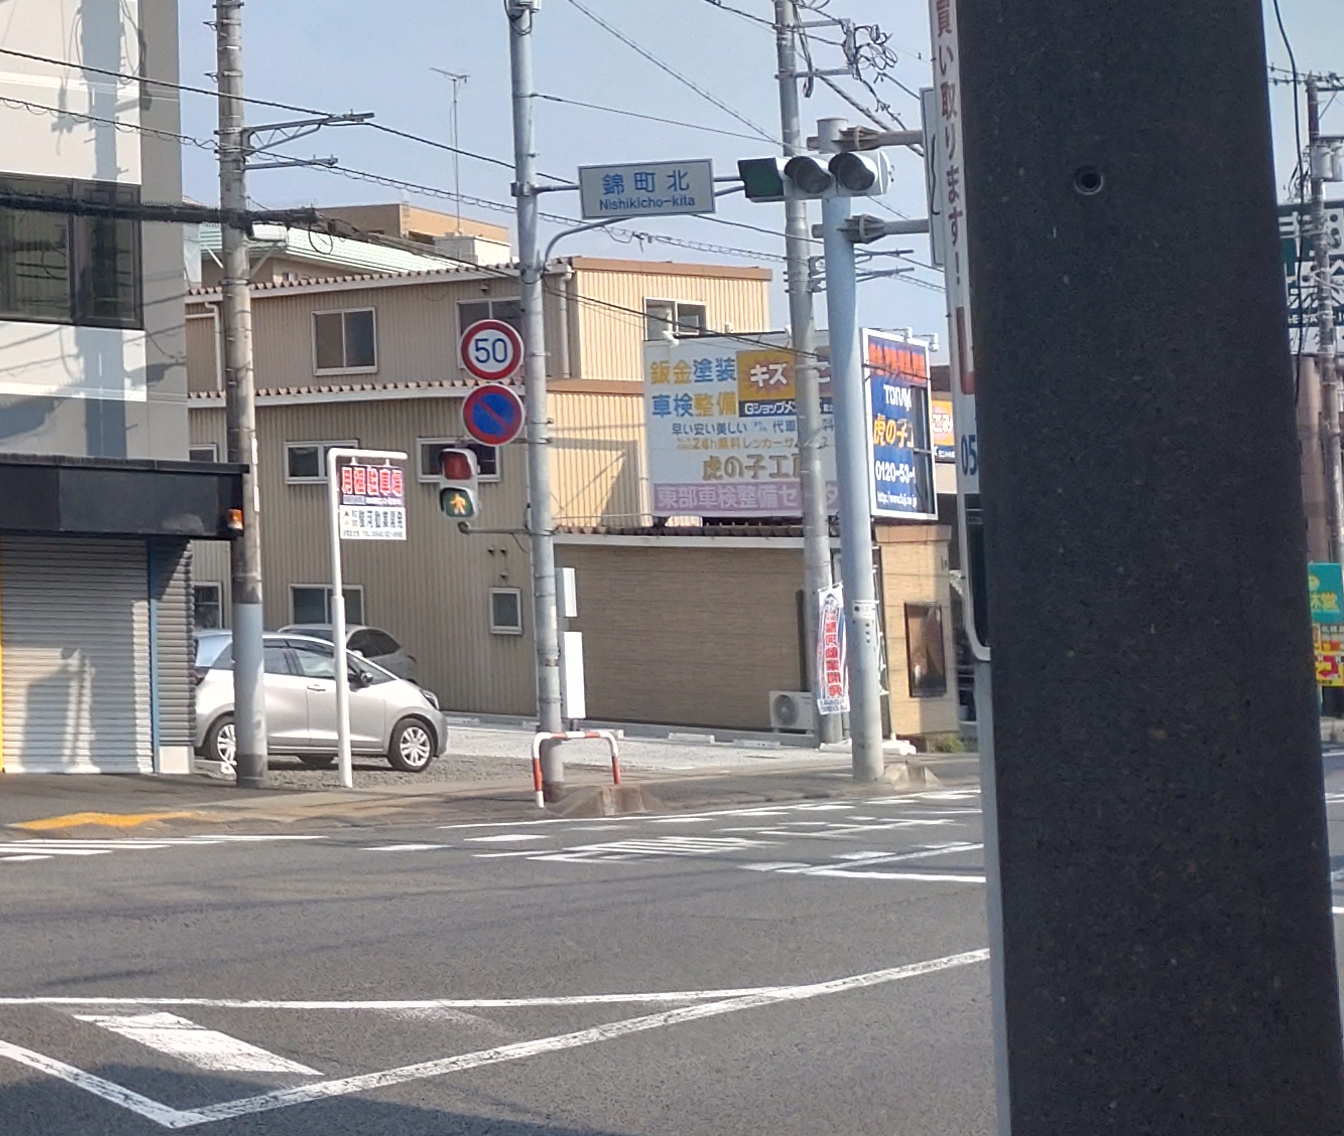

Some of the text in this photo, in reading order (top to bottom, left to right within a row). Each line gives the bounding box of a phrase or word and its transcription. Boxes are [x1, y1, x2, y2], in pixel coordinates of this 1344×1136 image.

[602, 169, 690, 195] 錦町北
[599, 194, 696, 211] Nishikicho-kita
[474, 338, 507, 363] 50
[652, 392, 737, 418] 車検整備
[961, 434, 977, 477] 05
[658, 482, 839, 510] 東部車検整備セタ
